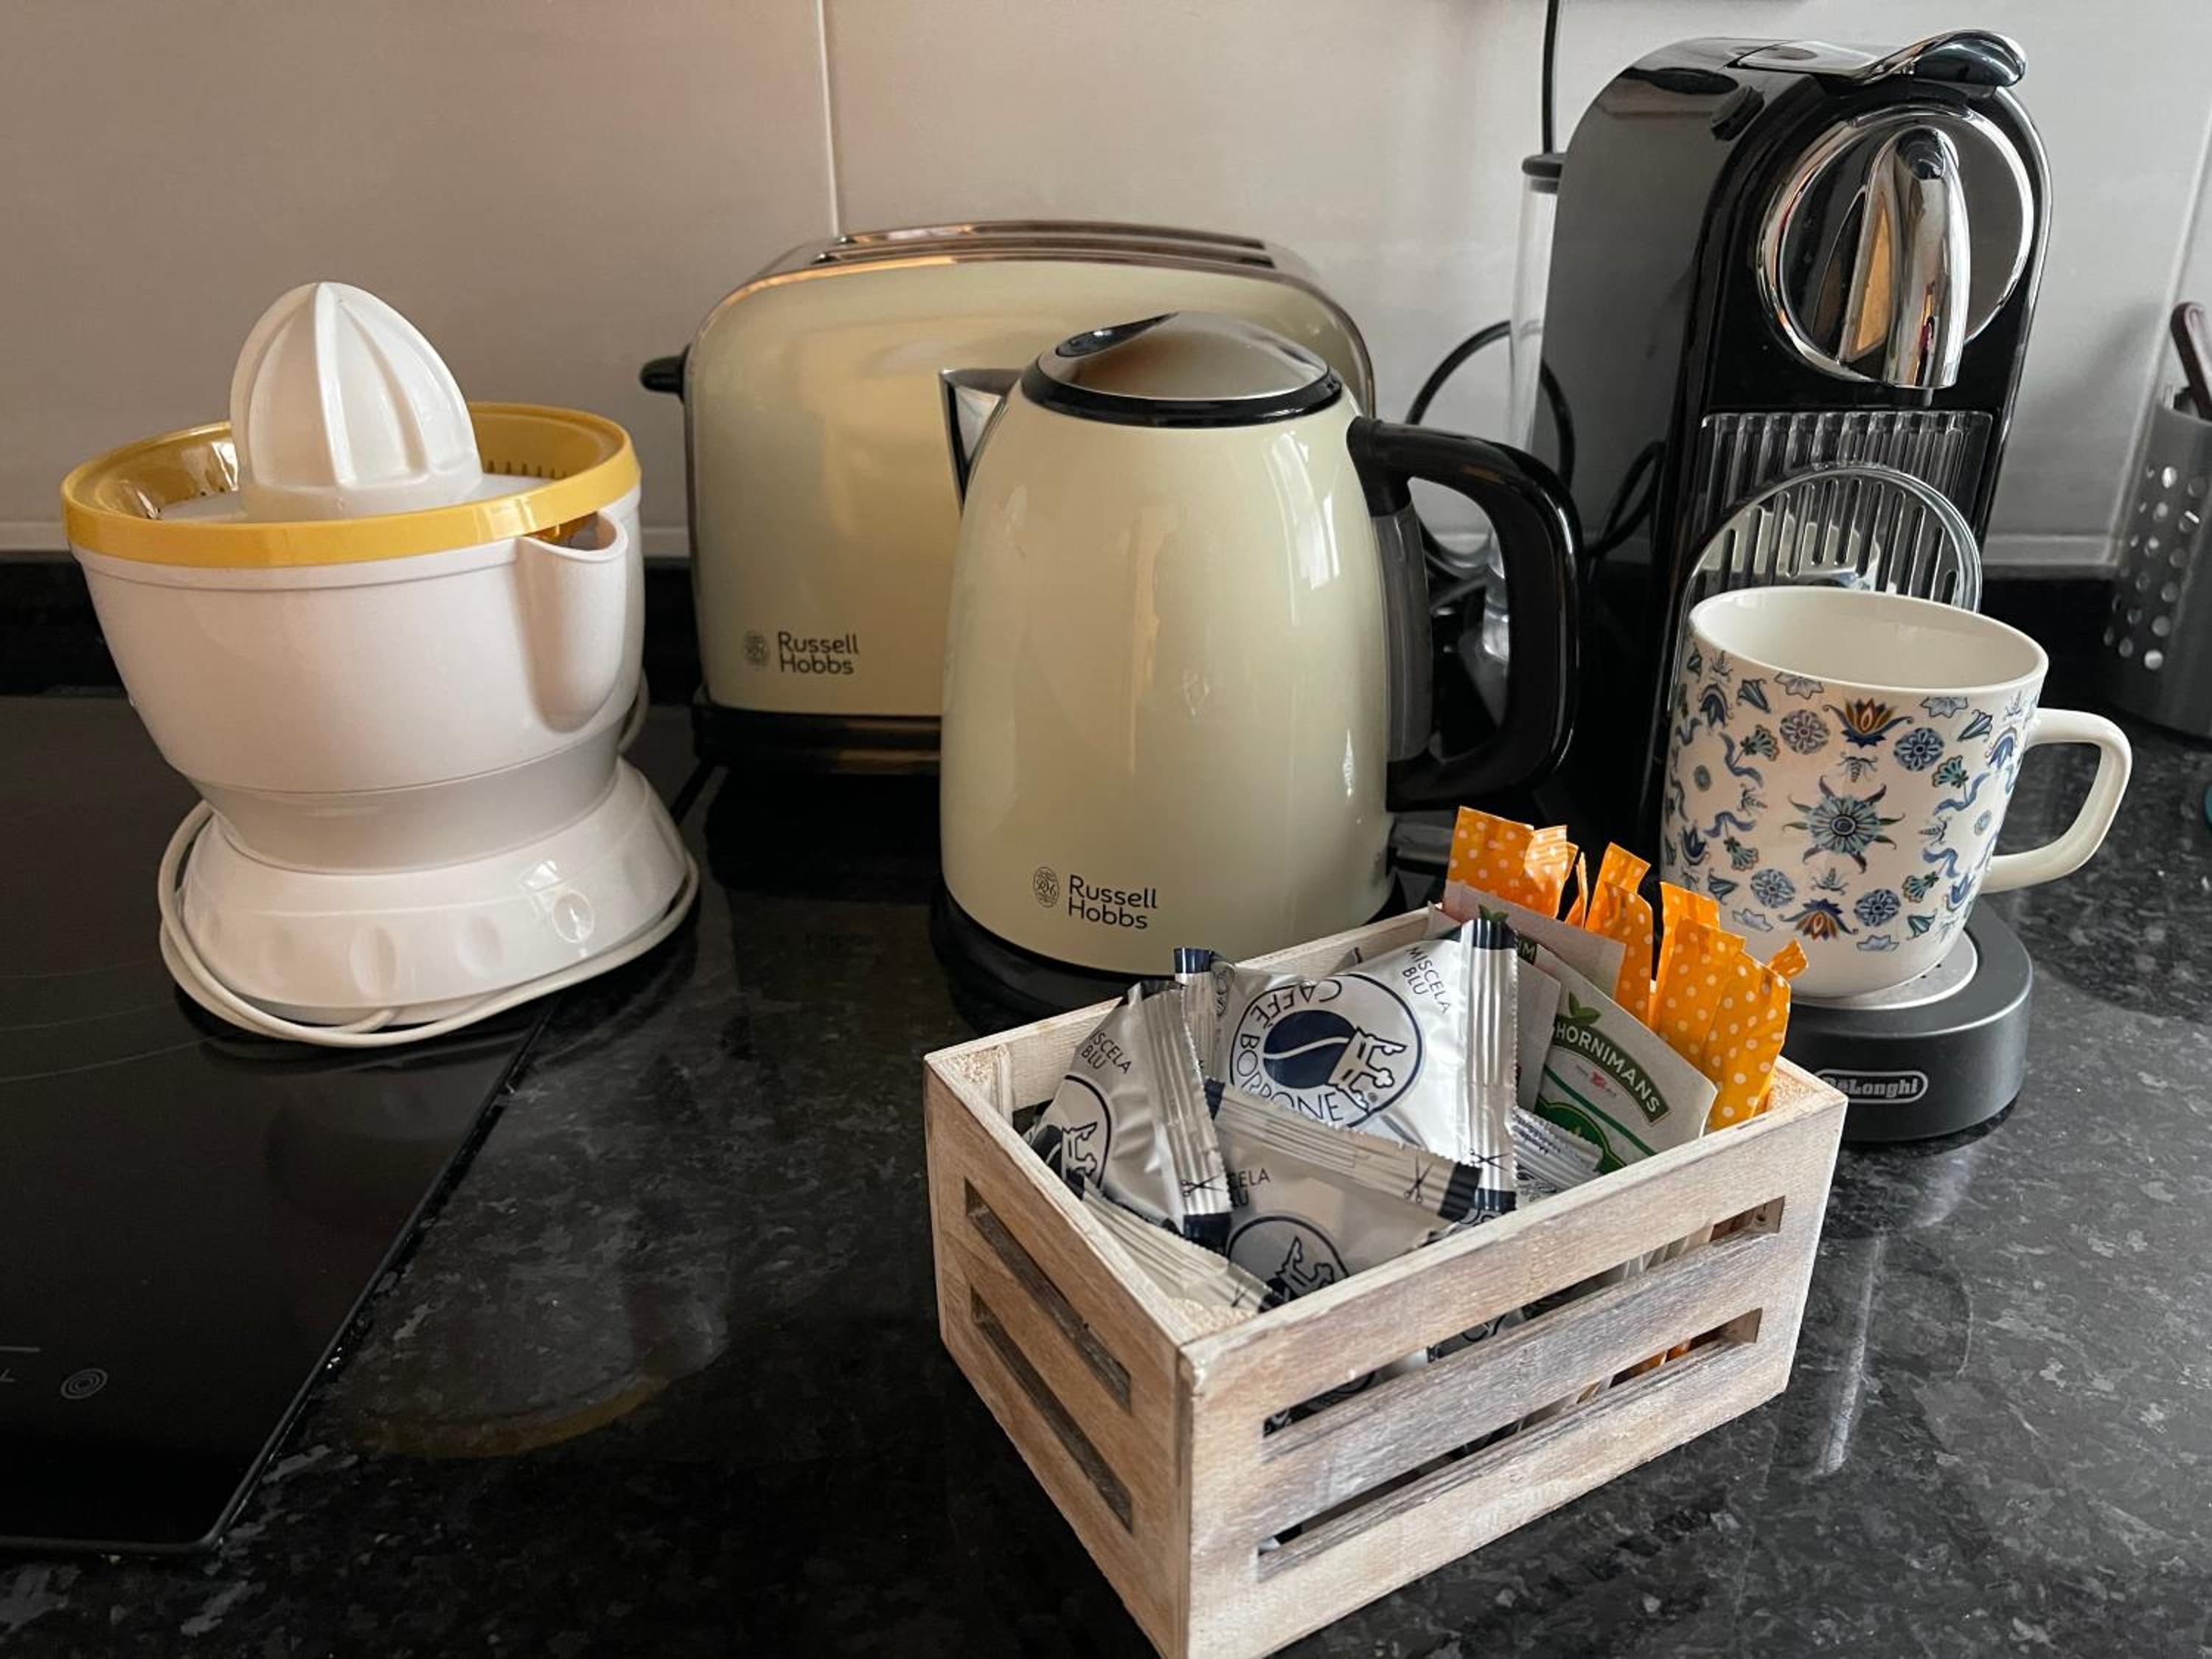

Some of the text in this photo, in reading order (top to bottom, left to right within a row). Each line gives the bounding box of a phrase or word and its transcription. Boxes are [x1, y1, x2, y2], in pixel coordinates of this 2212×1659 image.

[778, 631, 859, 655] Russell
[779, 653, 855, 675] Hobbs
[1070, 874, 1157, 909] Russell
[1069, 897, 1148, 929] Hobbs
[1402, 967, 1429, 995] BLU
[1405, 947, 1450, 1014] MISCELA
[1082, 1045, 1107, 1069] BLU
[1091, 1029, 1132, 1074] ISCELA
[1557, 1021, 1660, 1113] HORNIMANS
